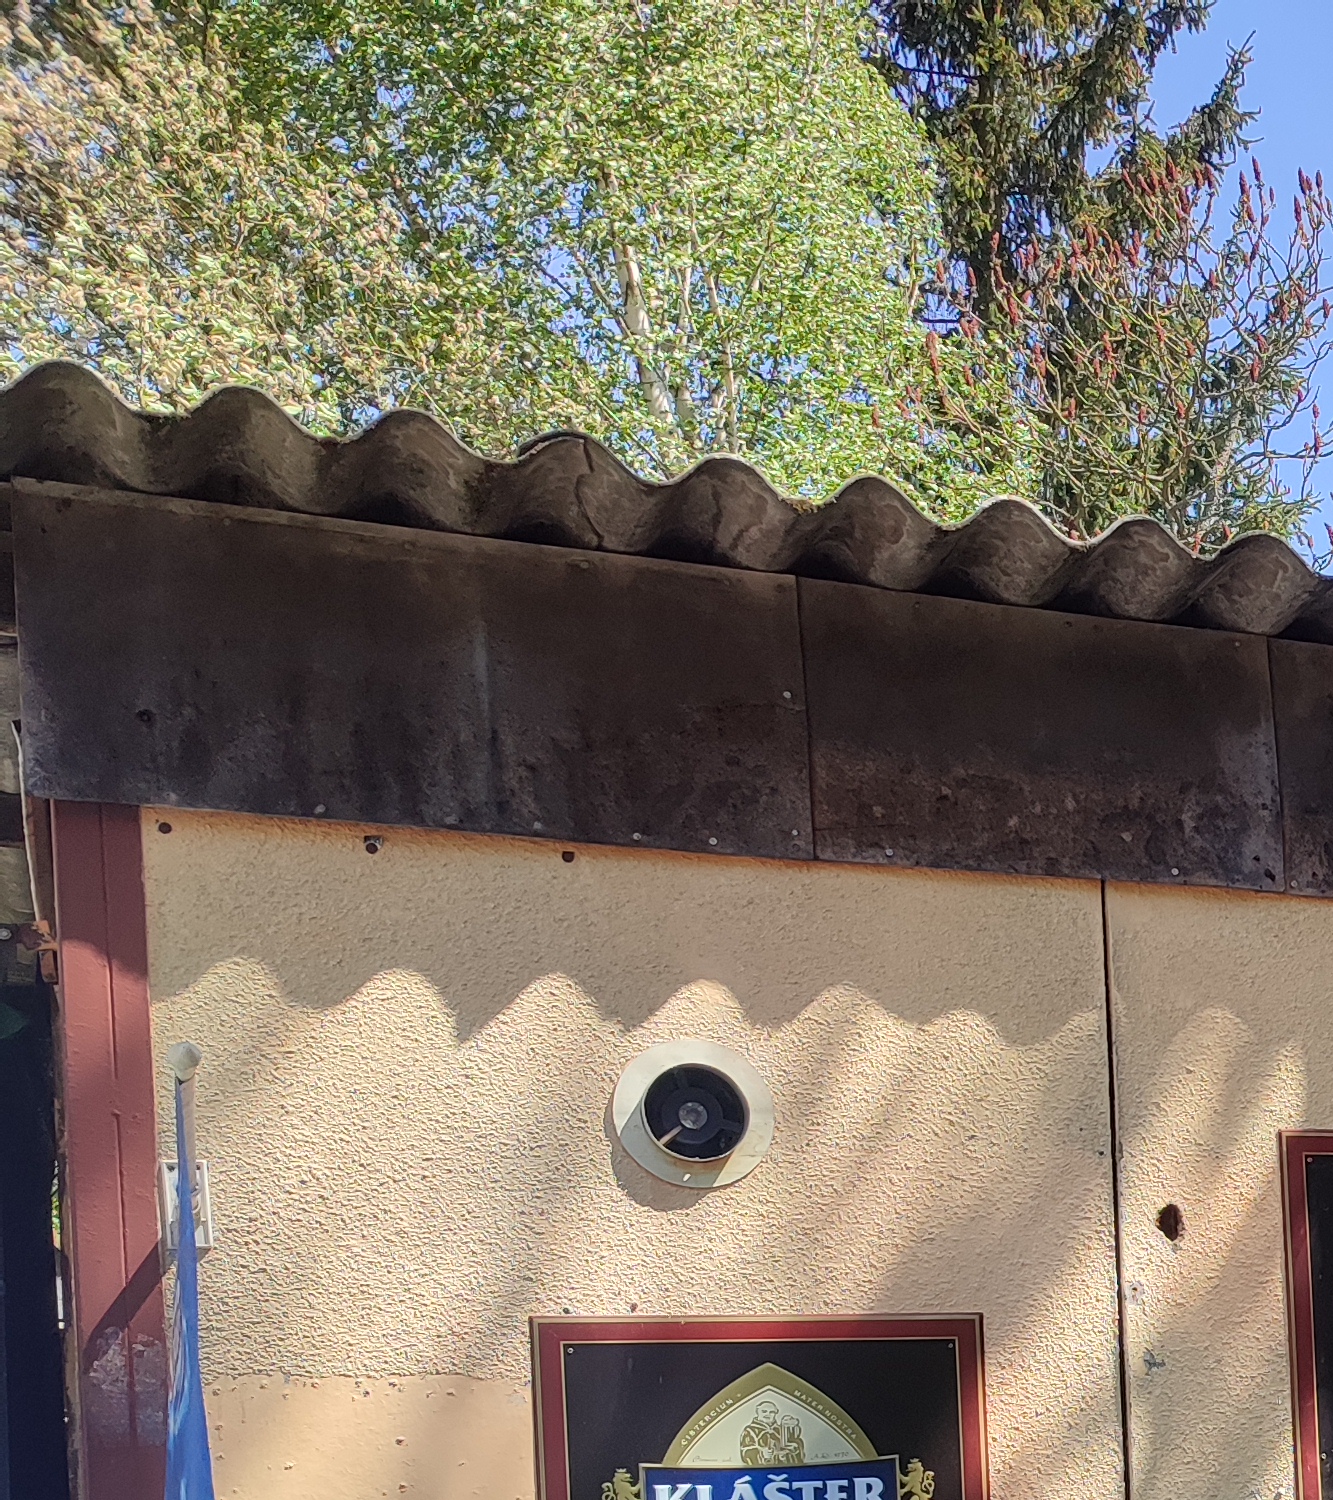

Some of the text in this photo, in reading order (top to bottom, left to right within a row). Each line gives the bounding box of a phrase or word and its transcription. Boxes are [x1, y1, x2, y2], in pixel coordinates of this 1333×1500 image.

[681, 1389, 857, 1447] CISTERCIUM MATER NOSTRA
